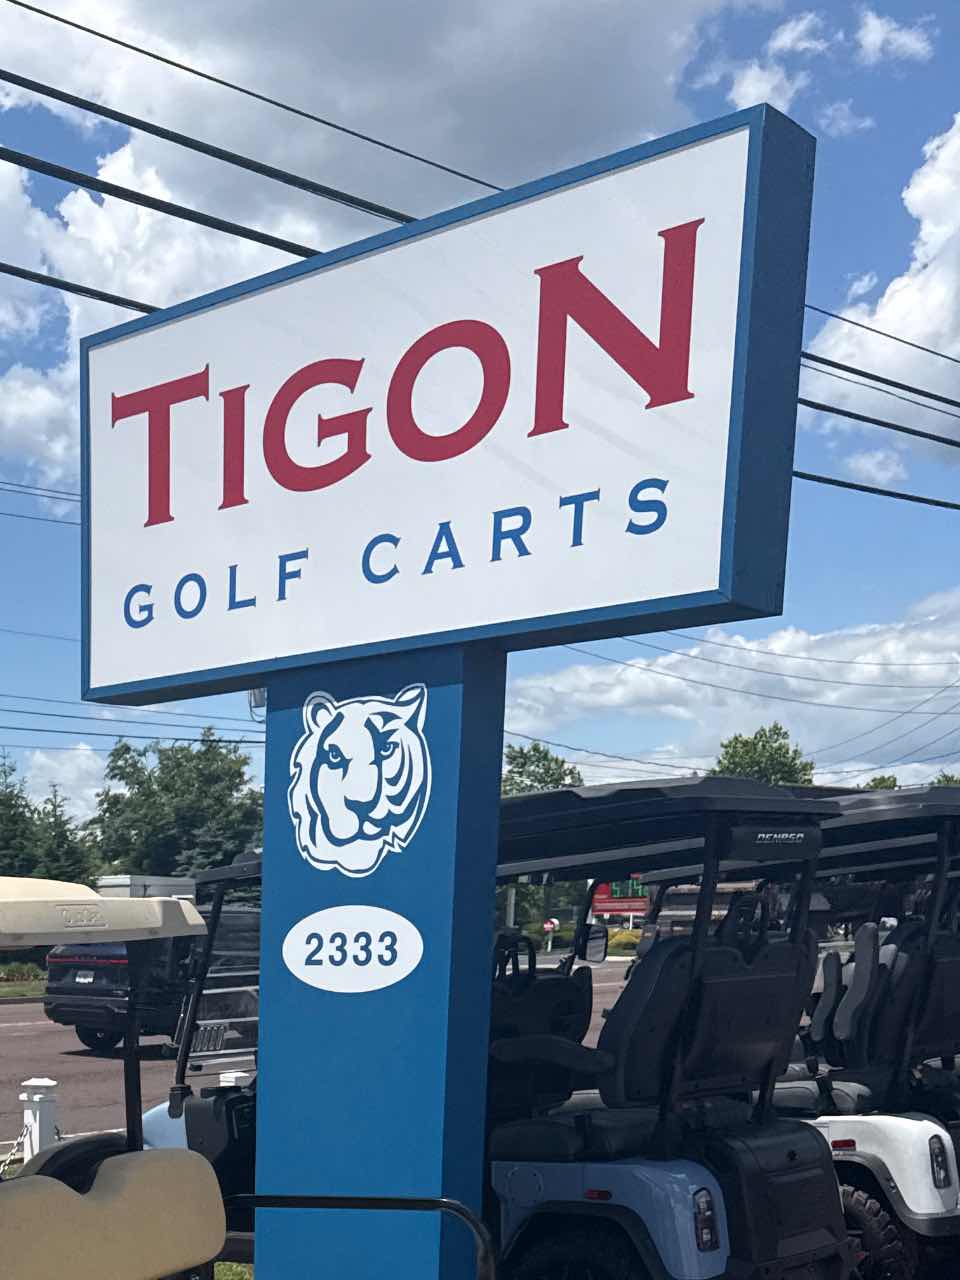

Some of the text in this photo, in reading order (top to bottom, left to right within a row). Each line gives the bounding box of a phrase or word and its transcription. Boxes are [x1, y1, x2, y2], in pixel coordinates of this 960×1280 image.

[111, 217, 705, 527] TIGON
[123, 478, 669, 629] GOLF CARTS
[304, 931, 398, 967] 2333
